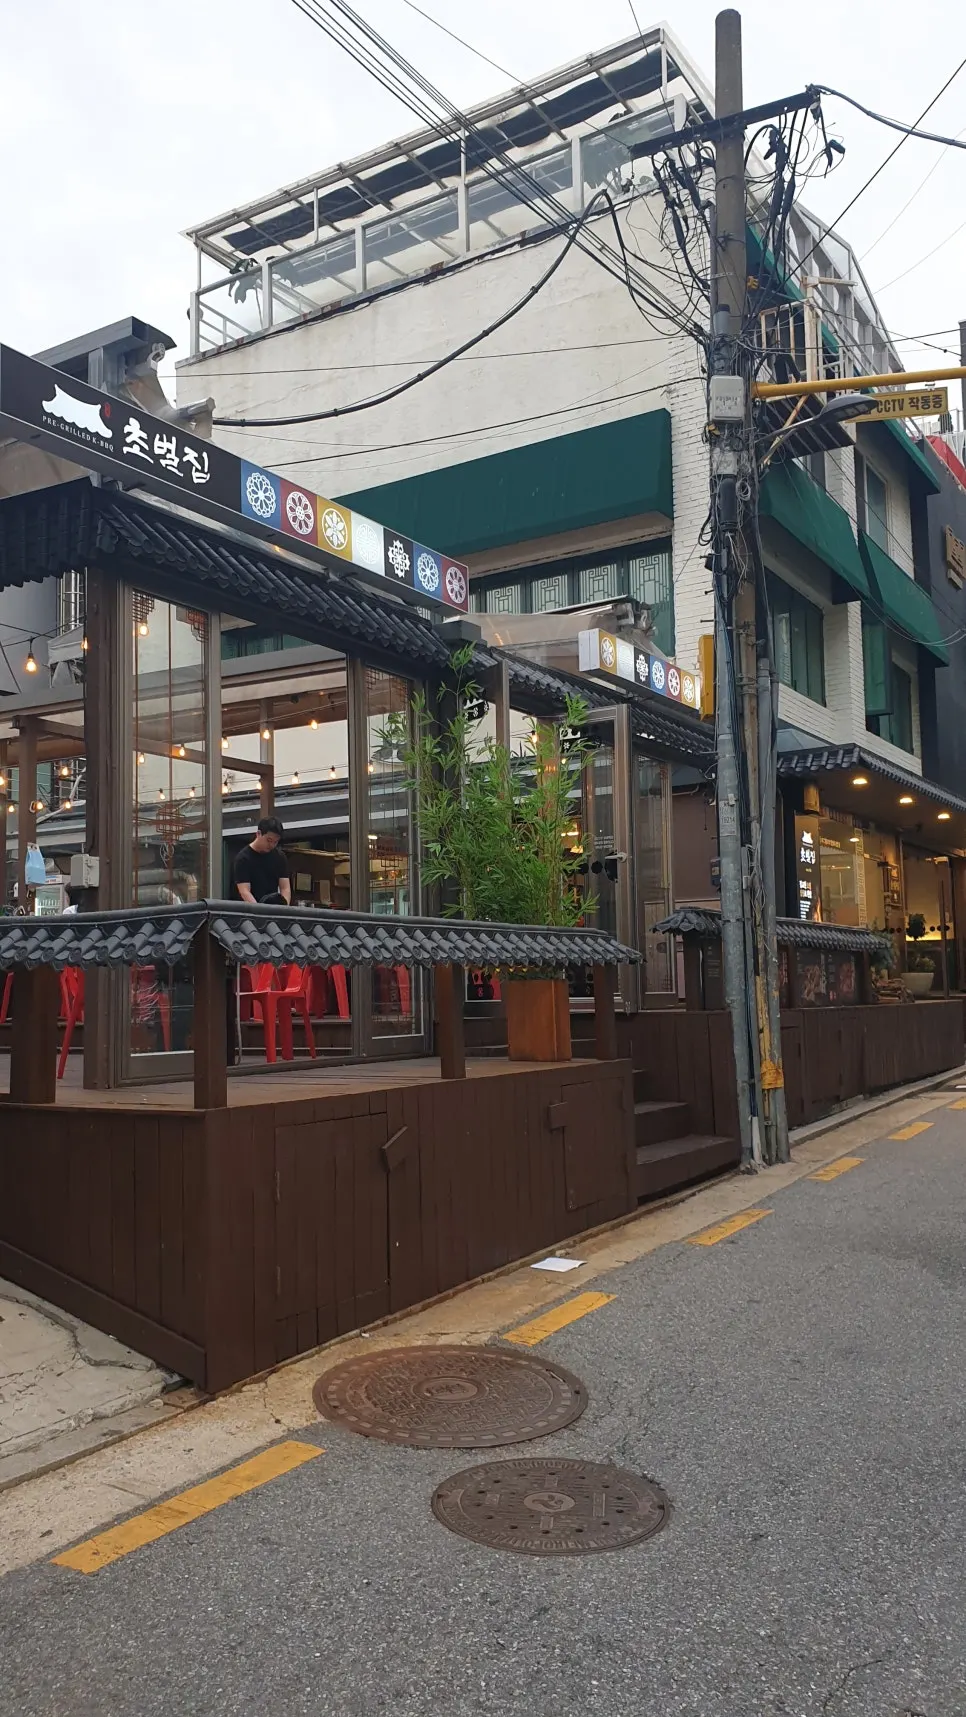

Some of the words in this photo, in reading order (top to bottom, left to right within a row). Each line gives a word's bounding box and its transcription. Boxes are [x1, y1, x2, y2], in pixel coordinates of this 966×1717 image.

[876, 398, 905, 414] CCTV
[908, 394, 943, 411] 작동중
[42, 415, 91, 441] PRE-GRILLED
[92, 436, 114, 453] K-BBQ
[122, 417, 211, 484] 초벌집
